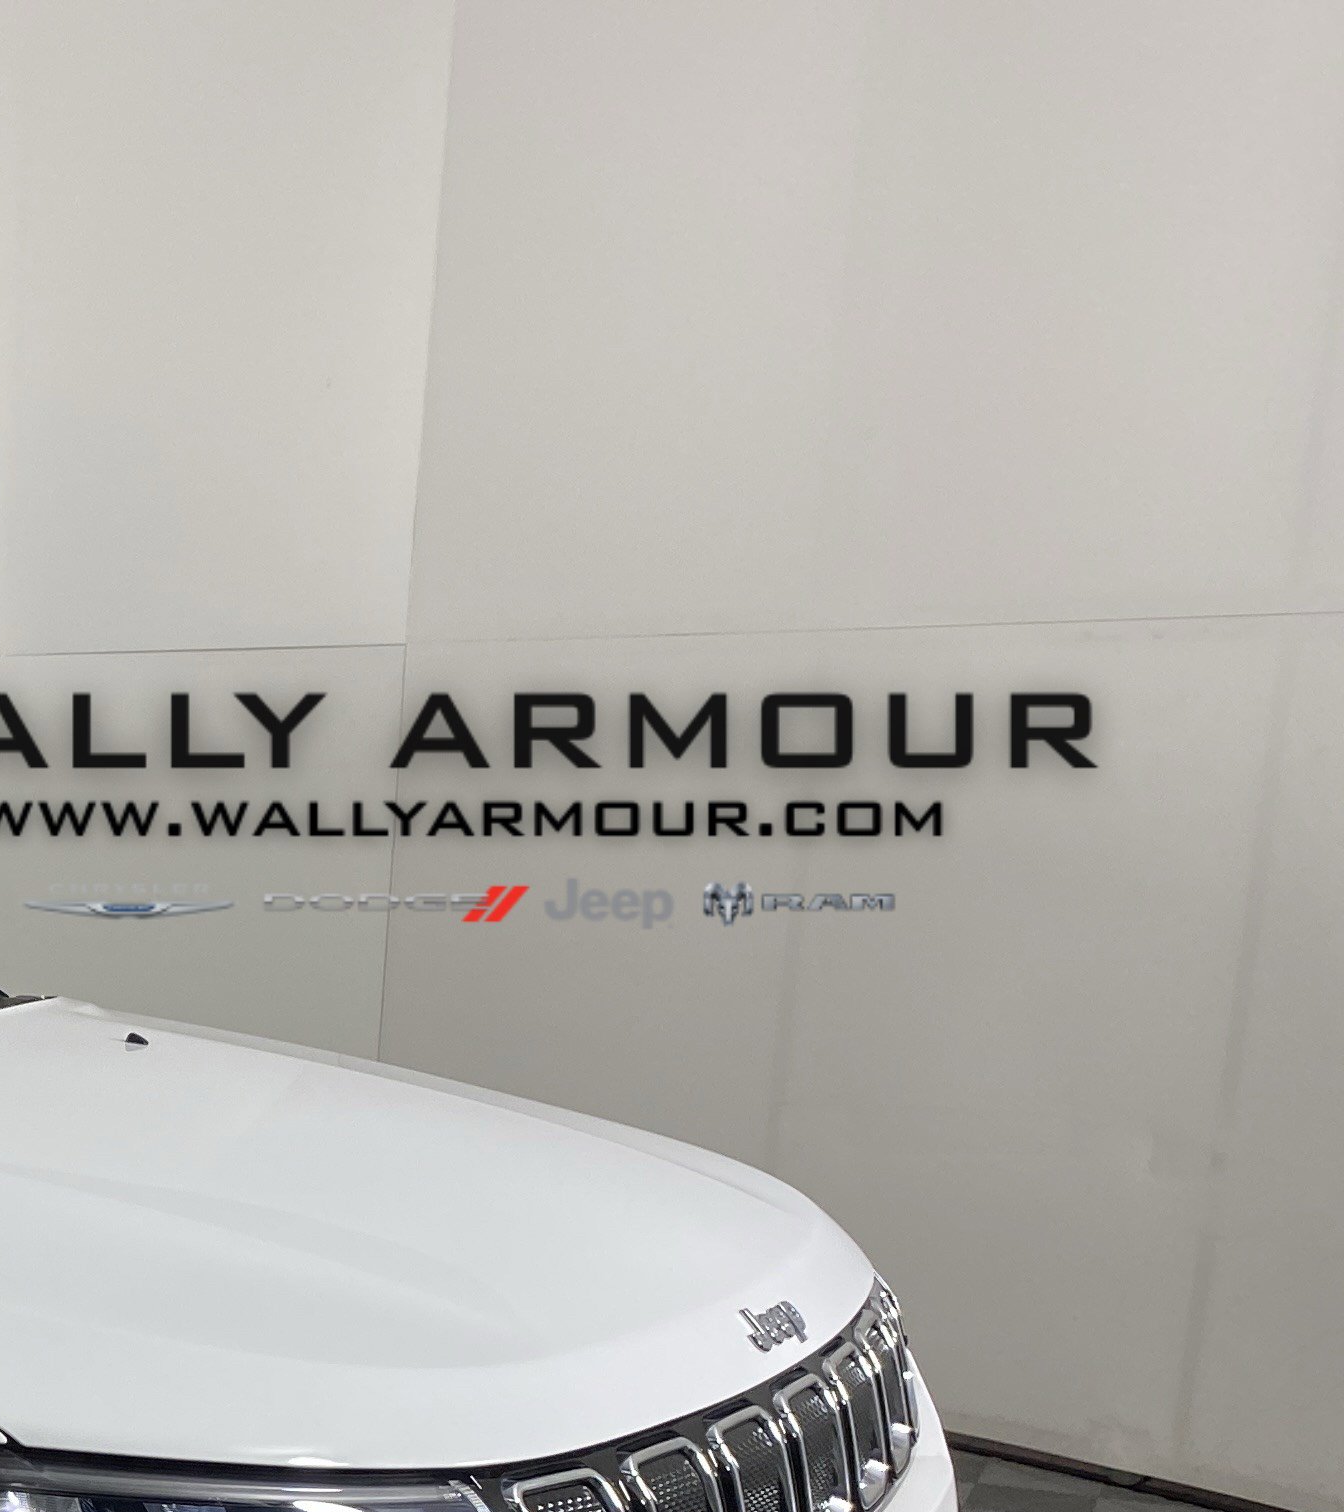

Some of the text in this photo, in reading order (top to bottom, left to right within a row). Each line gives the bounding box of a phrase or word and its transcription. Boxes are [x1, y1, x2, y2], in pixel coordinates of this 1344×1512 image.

[388, 692, 1099, 769] ARMOUR
[263, 893, 490, 912] DODGE
[544, 878, 674, 929] Jeep
[762, 893, 897, 912] RAM
[738, 1300, 808, 1354] Jeep
